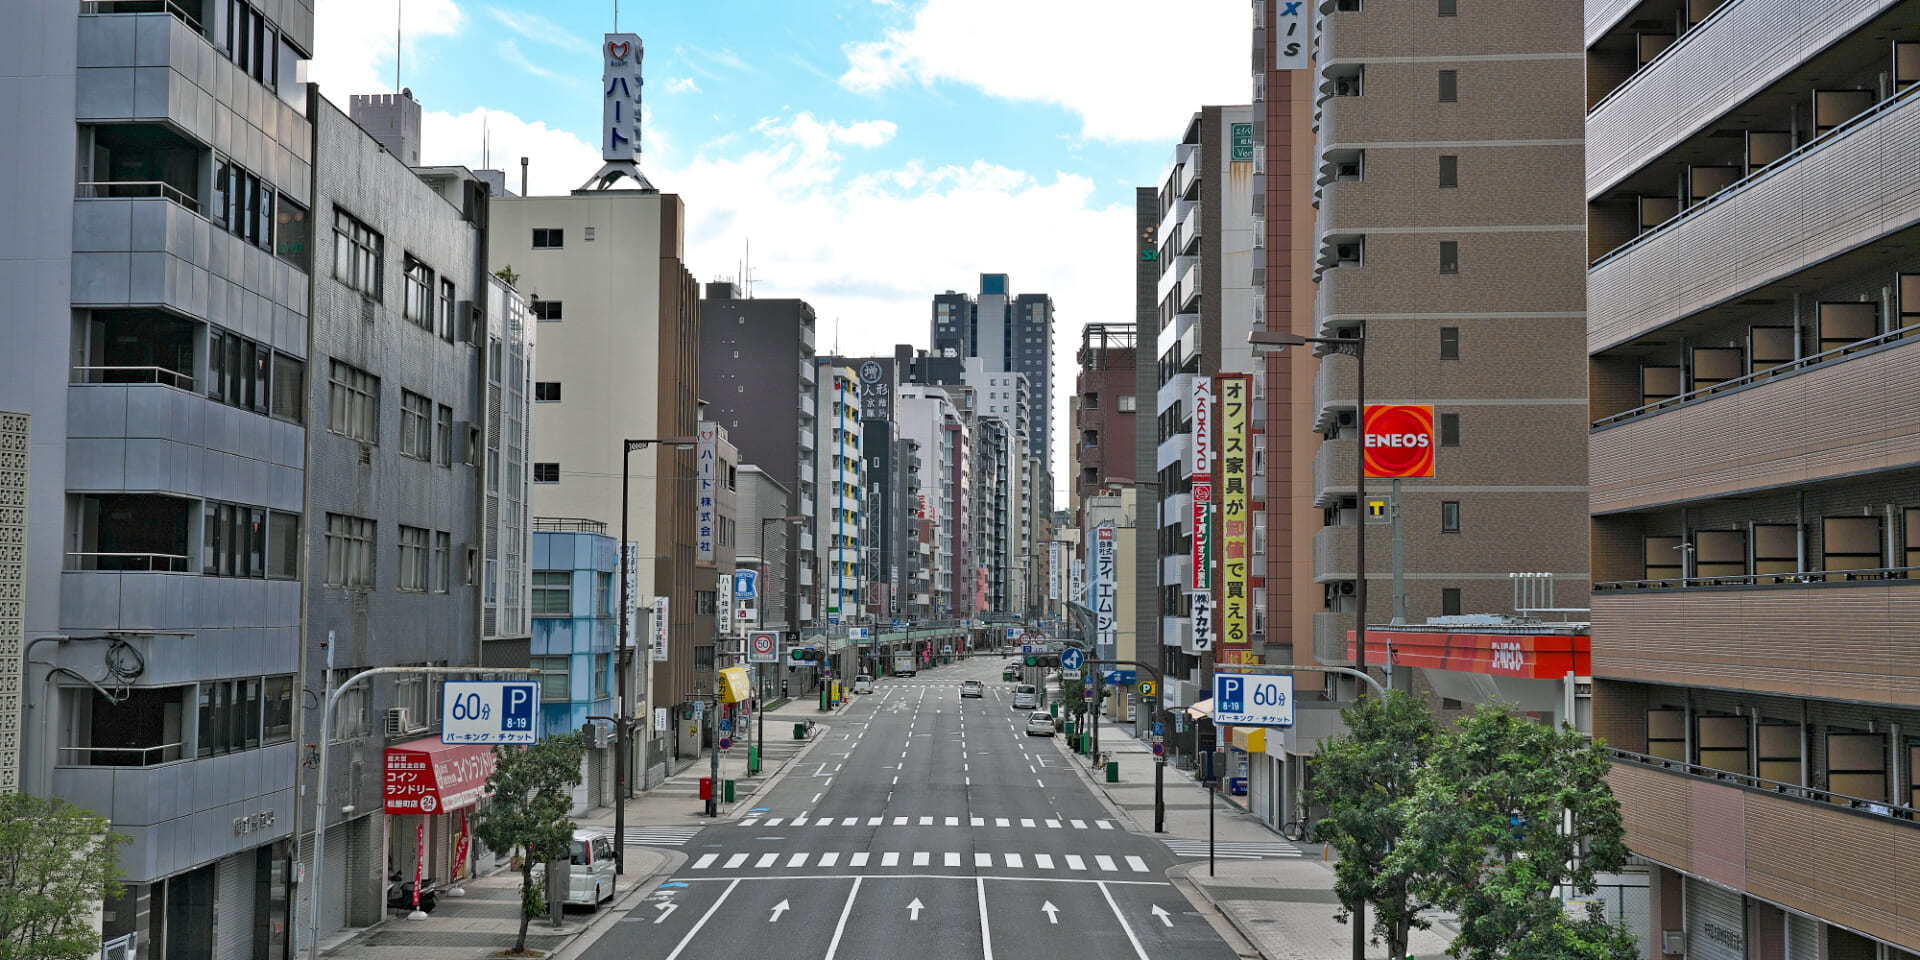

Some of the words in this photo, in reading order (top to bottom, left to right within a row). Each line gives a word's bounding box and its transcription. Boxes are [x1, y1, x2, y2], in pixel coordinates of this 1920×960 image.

[607, 77, 630, 150] ハート
[863, 383, 888, 396] 人形
[1197, 398, 1206, 470] KOKUYO
[1365, 433, 1429, 447] ENEOS
[700, 449, 712, 552] ハート株式会社
[1226, 383, 1244, 640] オフィス家具が卸値で買える
[757, 639, 768, 649] 50
[1492, 642, 1524, 671] ENEOS
[1143, 684, 1150, 693] P
[1226, 679, 1239, 700] P
[1253, 683, 1286, 706] 60分
[452, 692, 491, 720] 60分
[511, 689, 527, 714] P
[1222, 701, 1240, 711] 8-19
[506, 717, 526, 728] 8-19
[1218, 714, 1290, 722] パーキング・チケット
[446, 733, 532, 741] パーキング・チケット
[387, 772, 417, 782] コイン
[386, 784, 436, 795] ランドリー
